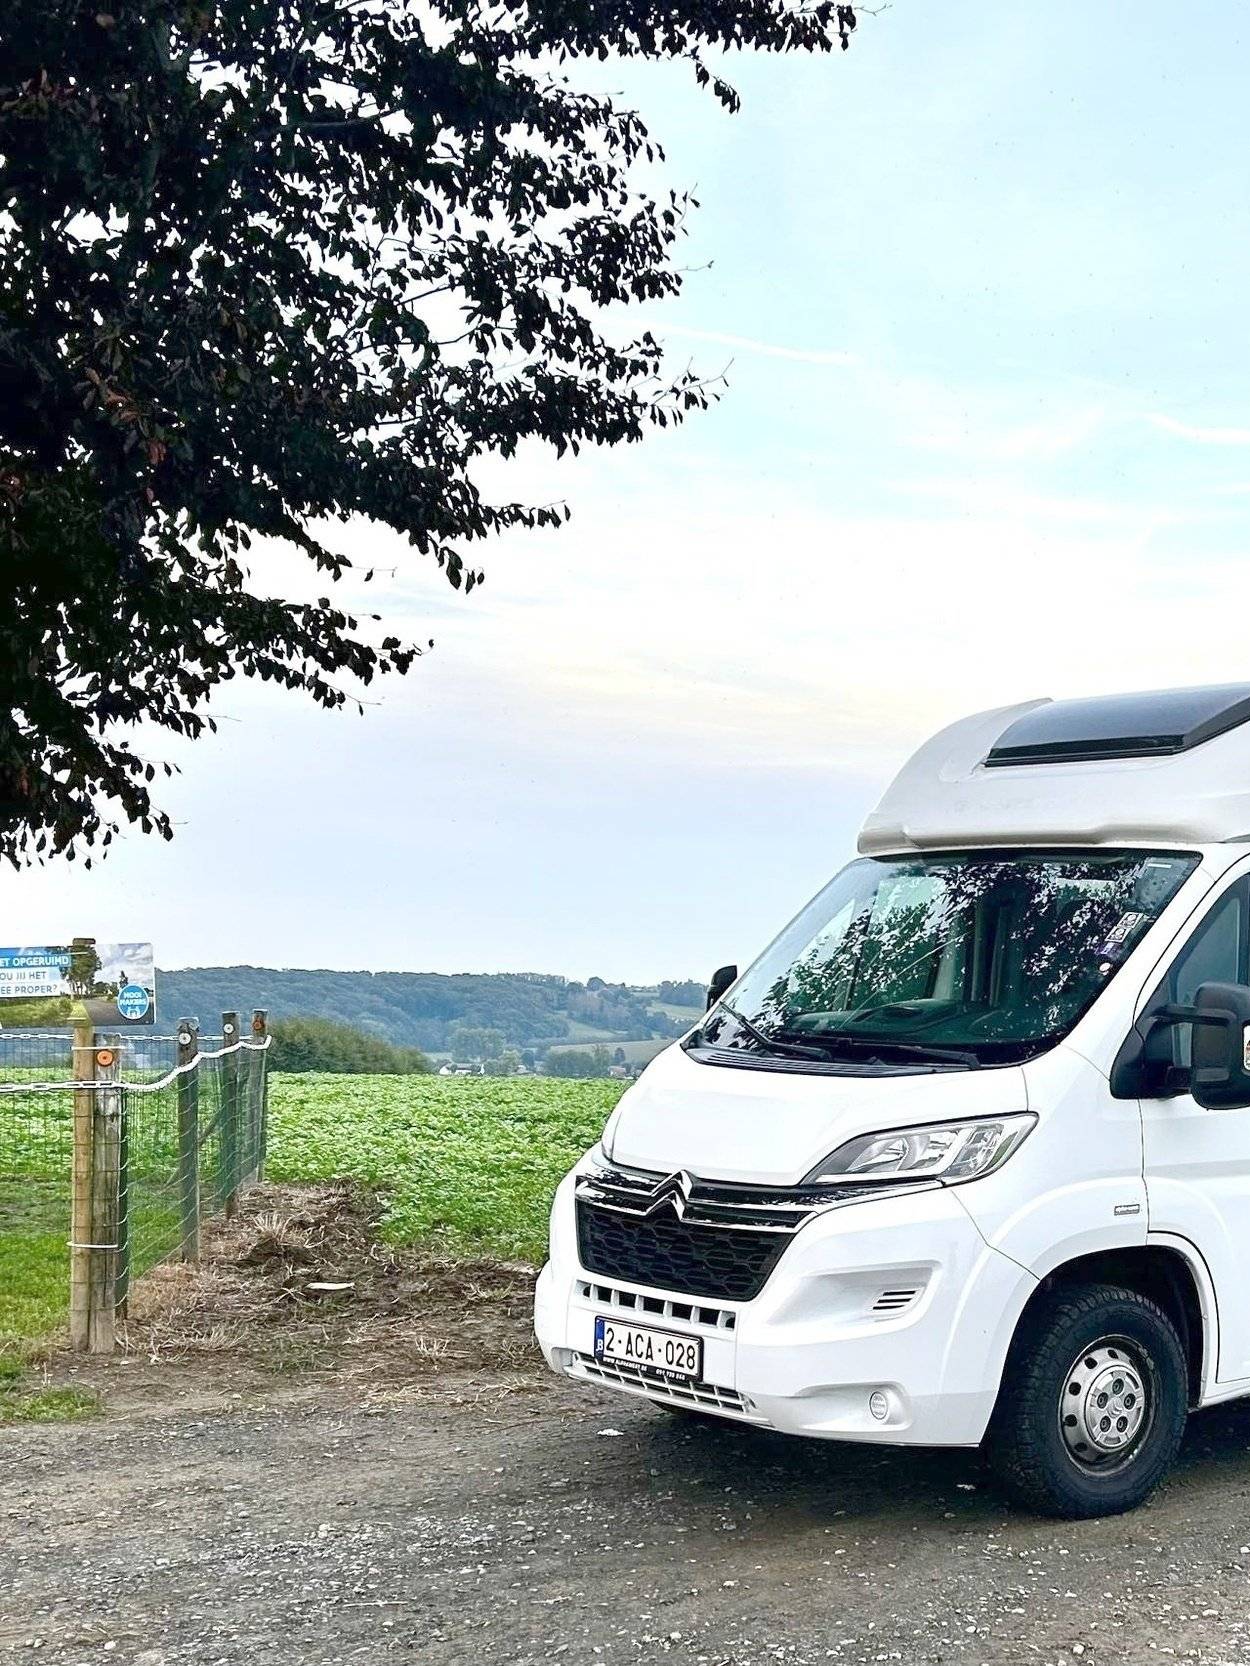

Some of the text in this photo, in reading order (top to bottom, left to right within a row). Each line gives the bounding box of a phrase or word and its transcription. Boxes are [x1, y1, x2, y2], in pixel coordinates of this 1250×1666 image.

[13, 955, 69, 966] OPGERUIMD
[29, 971, 46, 980] HET
[15, 984, 57, 994] PROPER?
[606, 1327, 696, 1370] 2-ACA-028
